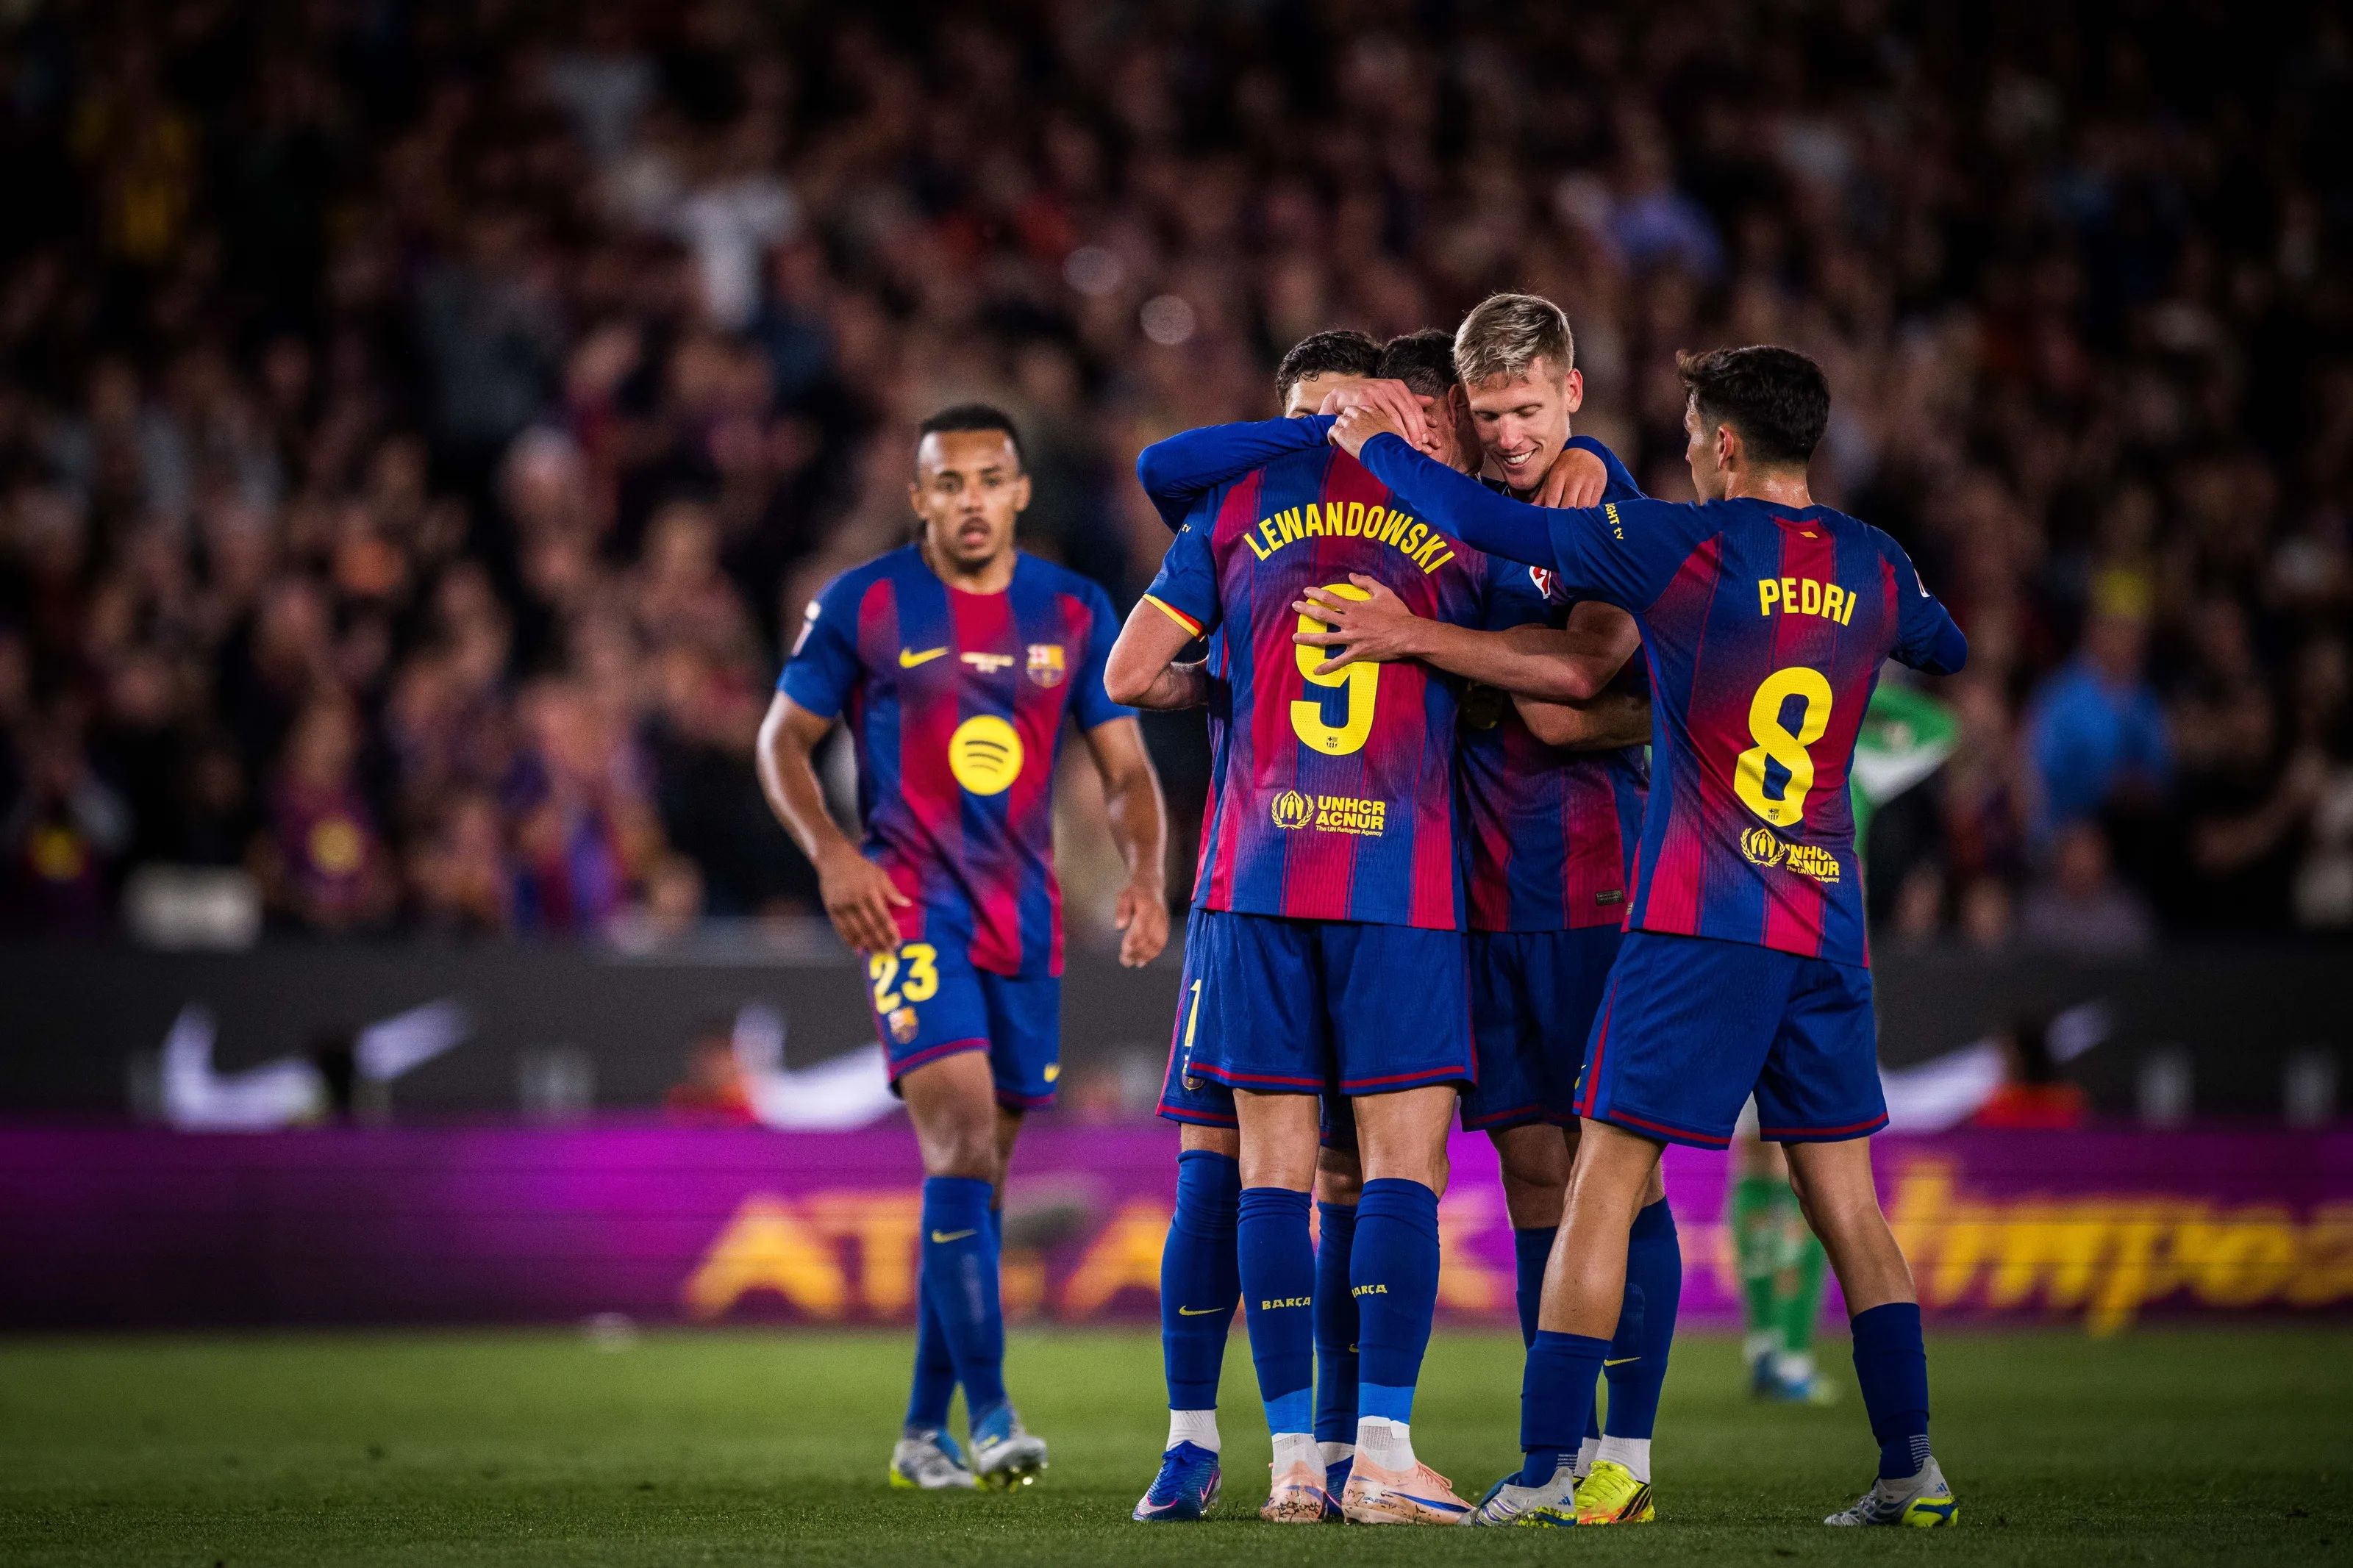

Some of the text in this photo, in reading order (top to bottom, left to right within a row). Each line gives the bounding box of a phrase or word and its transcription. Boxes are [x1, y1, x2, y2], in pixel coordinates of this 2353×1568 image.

[1243, 501, 1455, 575] LEWANDOWSKI
[1758, 578, 1857, 626] PEDRI
[1290, 583, 1380, 756] 9
[1734, 667, 1832, 828] 8
[1315, 811, 1385, 830] ACNUR
[1318, 795, 1386, 816] UNHCR
[1361, 829, 1383, 837] Agency
[1786, 856, 1840, 876] ANUR
[869, 942, 939, 1014] 23
